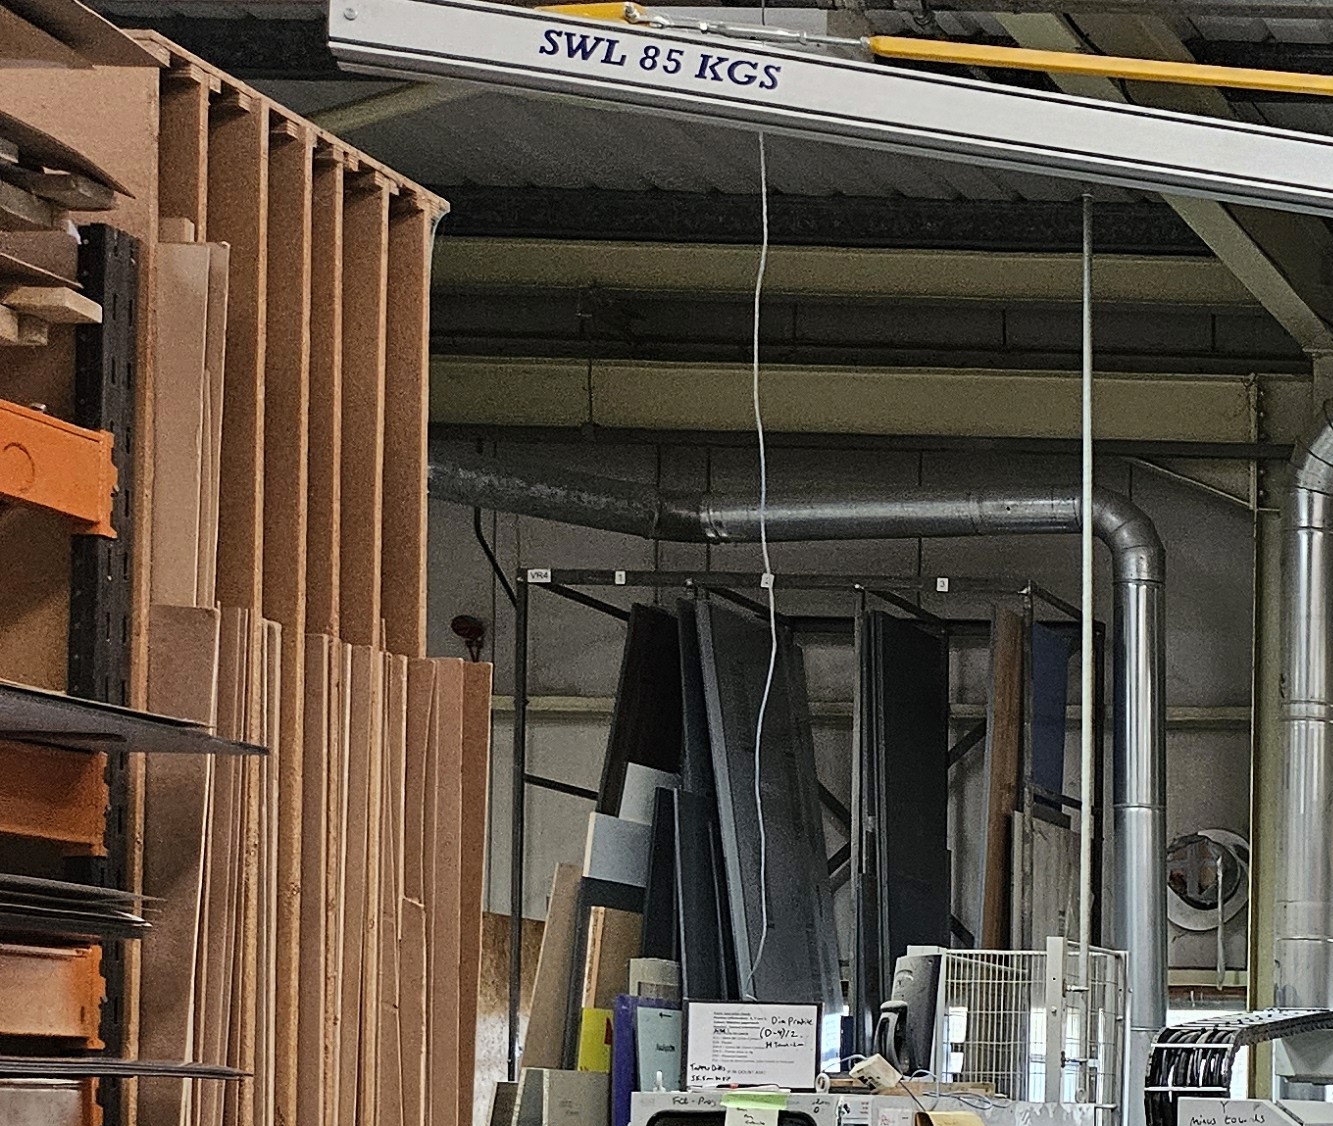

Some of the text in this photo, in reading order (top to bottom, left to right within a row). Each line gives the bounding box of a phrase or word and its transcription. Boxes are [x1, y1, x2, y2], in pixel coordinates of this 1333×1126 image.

[538, 29, 782, 90] SWL 85 KGS
[530, 571, 548, 580] VR4
[1220, 1101, 1229, 1113] Y
[1224, 1114, 1266, 1124] towds
